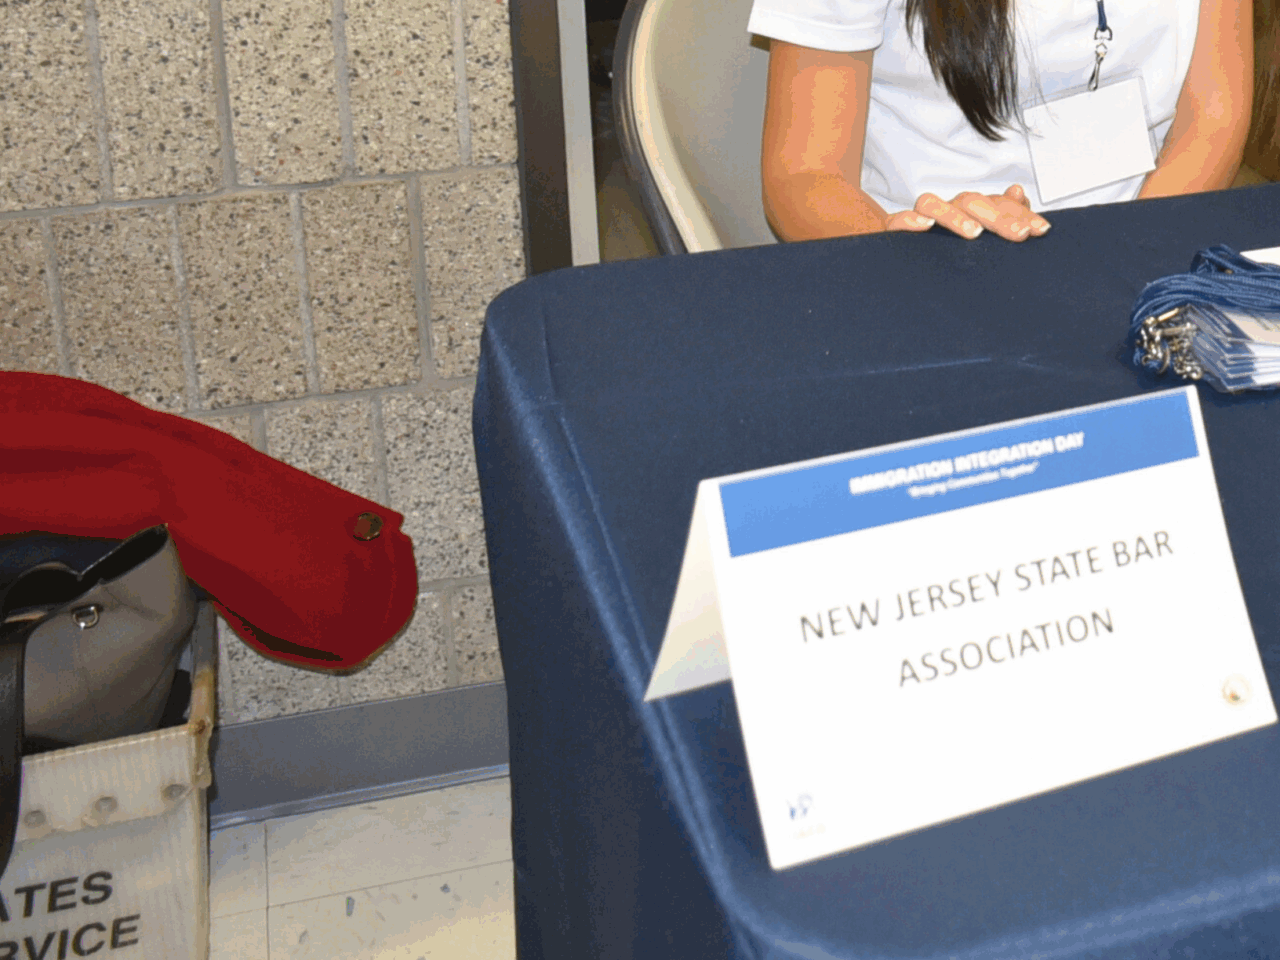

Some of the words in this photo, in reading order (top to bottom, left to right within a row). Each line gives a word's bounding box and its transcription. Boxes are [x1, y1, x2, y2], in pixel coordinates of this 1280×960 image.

[954, 438, 1055, 473] INTEGRATION
[1055, 430, 1085, 452] DAY
[800, 598, 880, 643] NEW
[896, 569, 1002, 622] JERSEY
[1014, 546, 1103, 592] STATE
[1112, 530, 1174, 568] BAR
[899, 607, 1114, 688] ASSOCIATION
